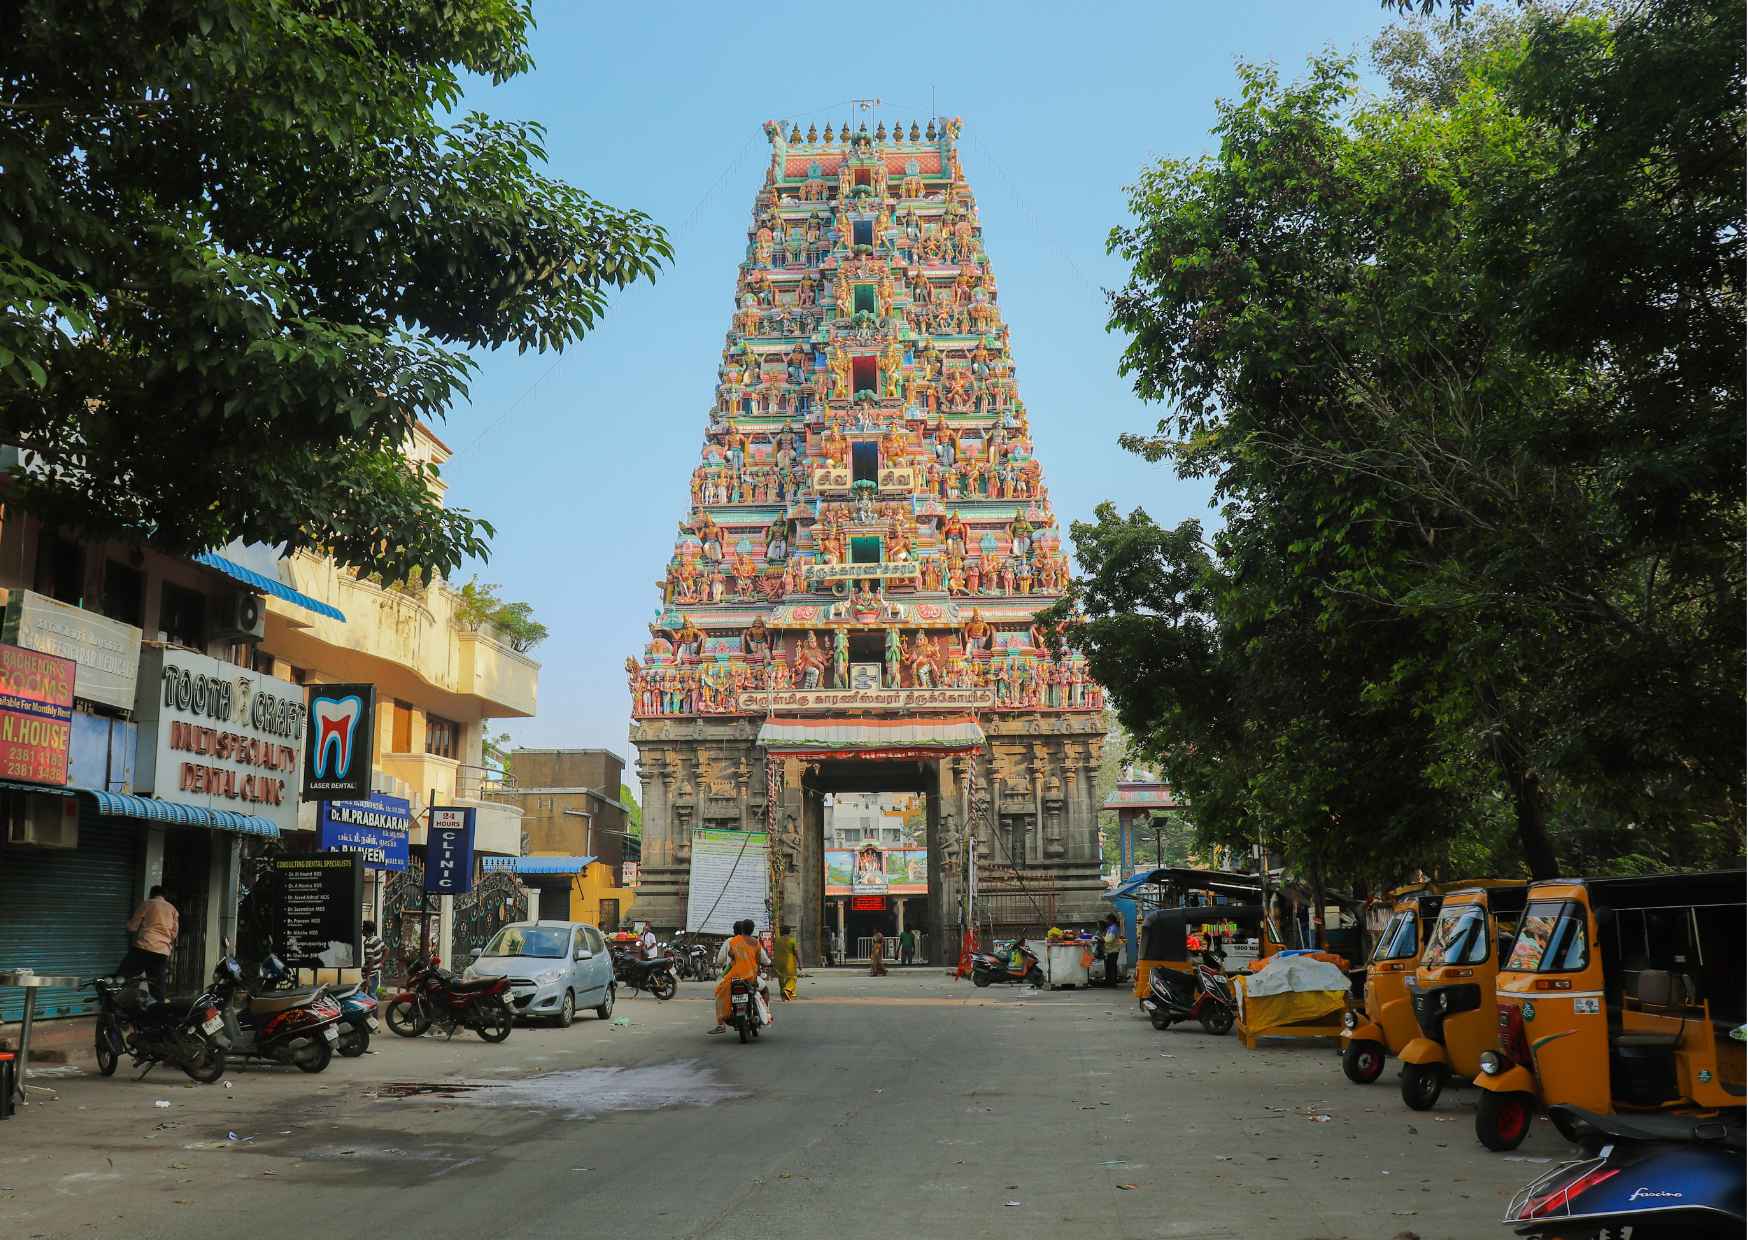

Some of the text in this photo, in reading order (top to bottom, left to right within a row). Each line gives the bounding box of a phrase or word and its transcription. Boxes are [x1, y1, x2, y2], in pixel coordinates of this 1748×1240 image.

[162, 664, 307, 741] TOOTH CRAFT
[742, 692, 810, 707] அருள்மிகு
[2, 715, 68, 751] N.HOUSE
[180, 761, 240, 800] DENTAL
[310, 782, 355, 790] LASER DENTAL
[442, 812, 455, 820] 24
[438, 831, 457, 888] CLINIC
[1627, 1187, 1683, 1201] fascino
